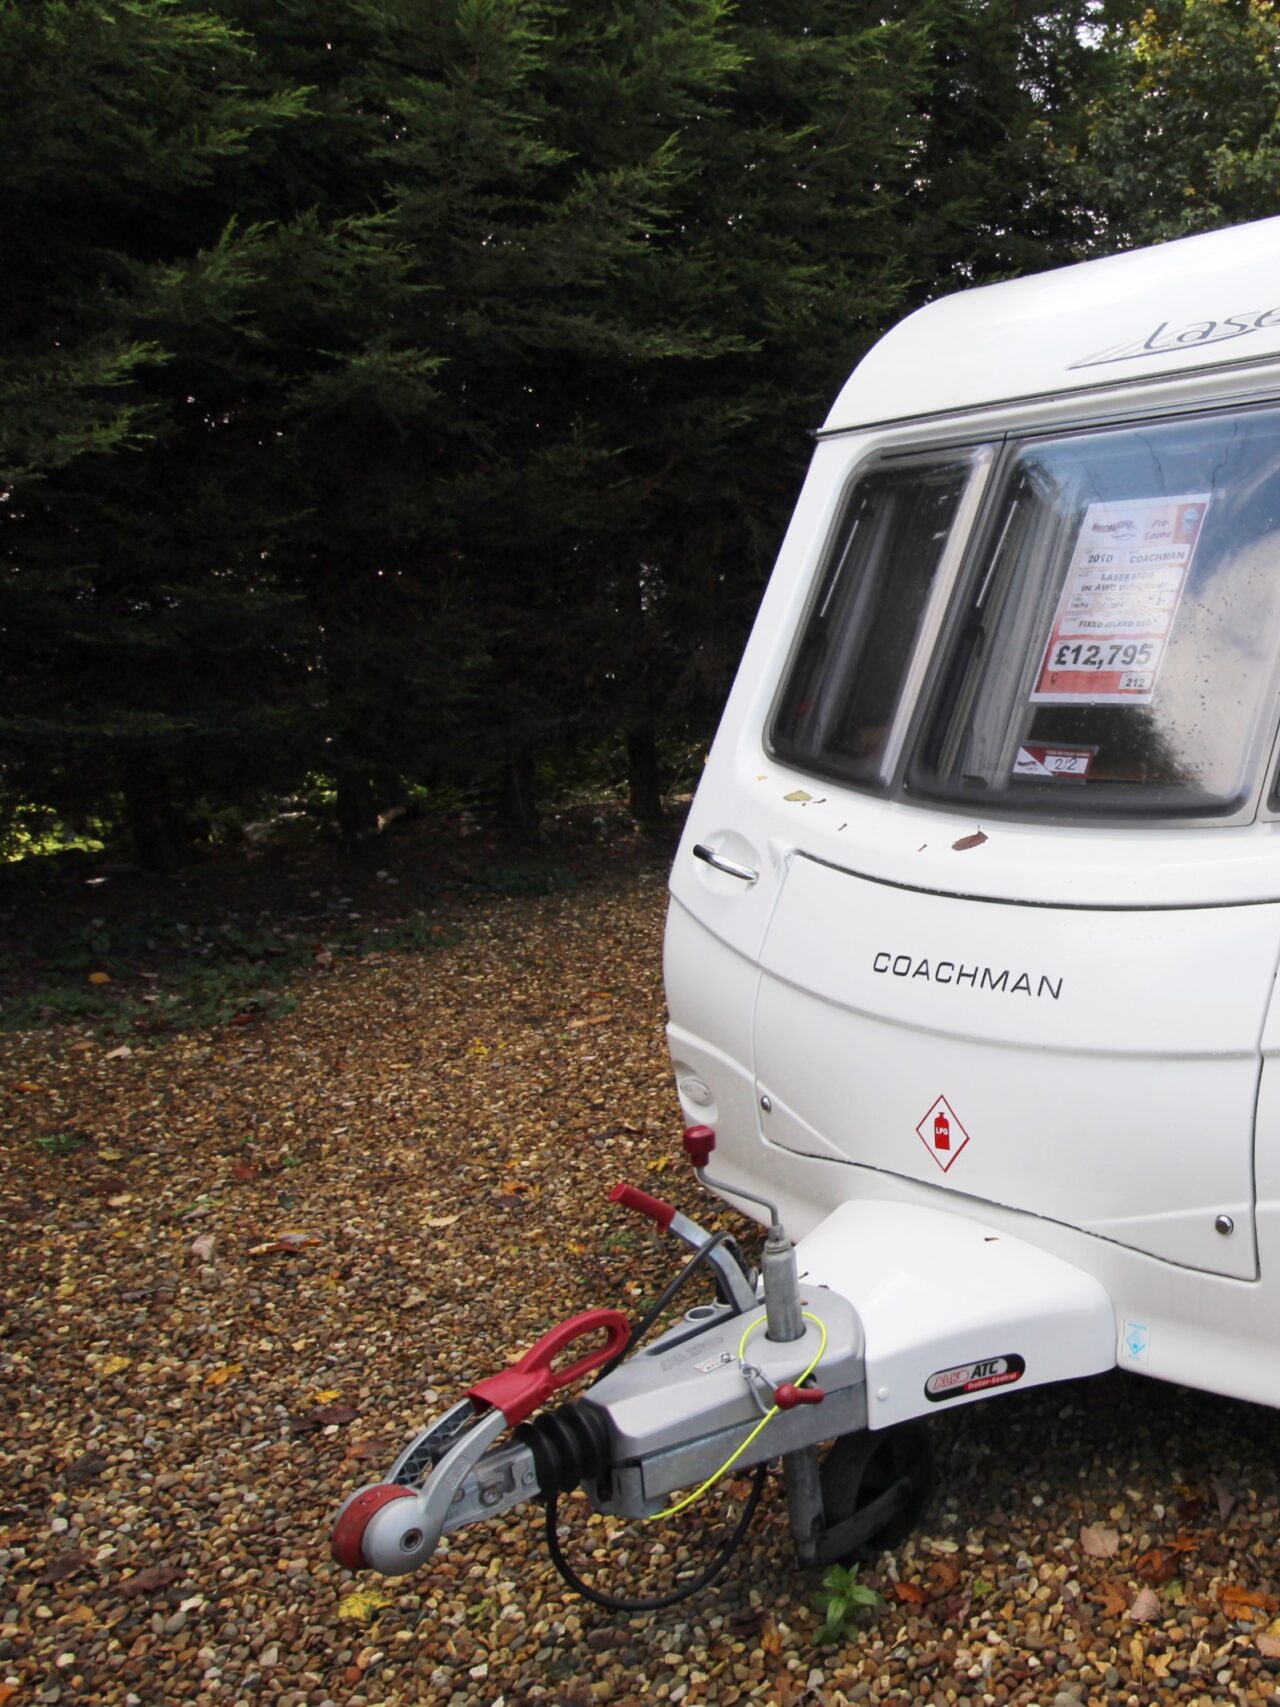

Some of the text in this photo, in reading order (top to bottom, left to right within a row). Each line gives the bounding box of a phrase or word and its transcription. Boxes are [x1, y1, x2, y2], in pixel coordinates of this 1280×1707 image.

[1088, 554, 1114, 564] 2010
[1129, 551, 1186, 564] COACHMAN
[1101, 573, 1130, 582] LASER
[1079, 620, 1104, 628] FIXED
[1054, 642, 1153, 670] £12,795
[1125, 677, 1145, 688] 212
[1055, 758, 1078, 771] 212
[872, 952, 1064, 1000] COACHMAN
[935, 1126, 949, 1136] LPG
[971, 1360, 1000, 1379] ATC
